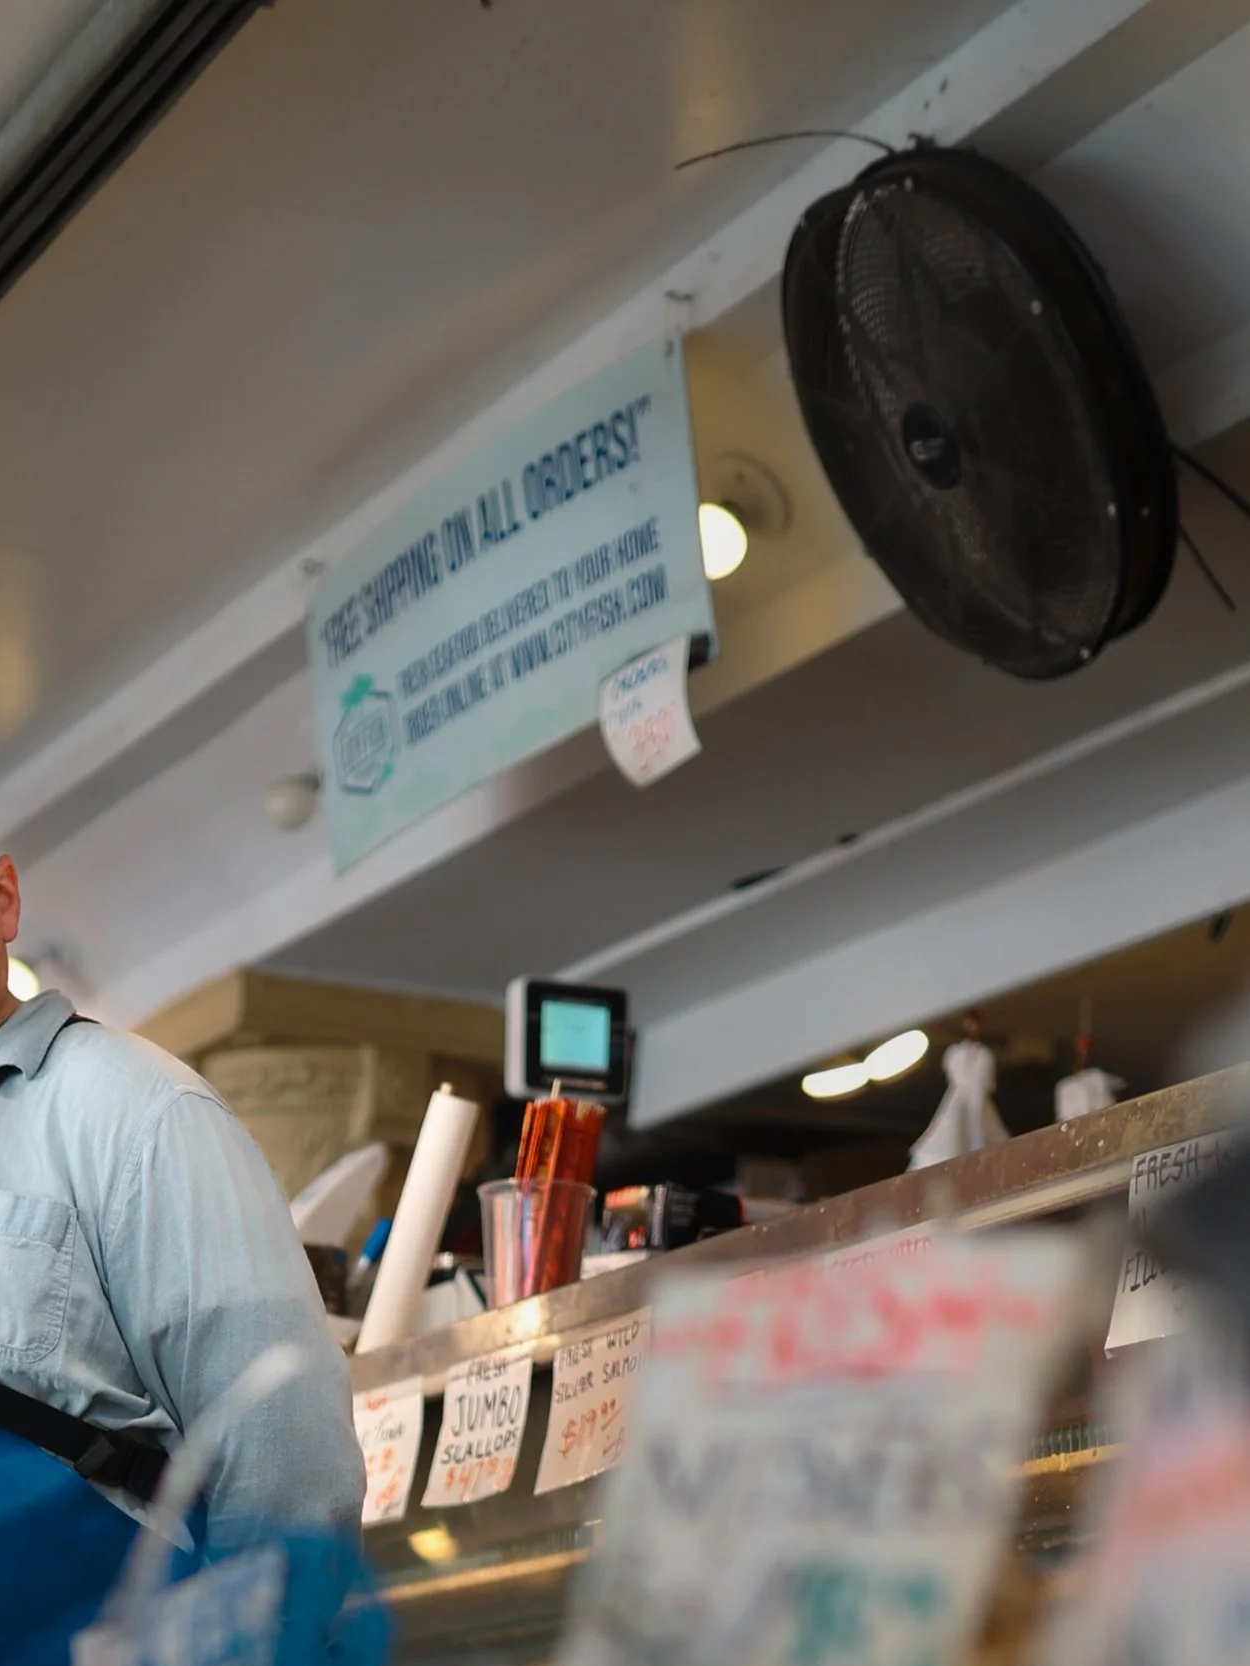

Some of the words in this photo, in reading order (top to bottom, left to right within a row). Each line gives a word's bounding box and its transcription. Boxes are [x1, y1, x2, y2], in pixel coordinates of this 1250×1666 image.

[359, 530, 442, 637] SHIPPING
[440, 503, 477, 575] ON
[477, 478, 523, 553] ALL
[551, 564, 571, 603] TO
[574, 541, 612, 590] YOUR
[615, 514, 661, 569] HOME
[1133, 1141, 1199, 1195] FRESH
[606, 1320, 640, 1351] WILD
[466, 1357, 510, 1387] FRESH
[554, 1370, 595, 1405] SILVER
[451, 1384, 523, 1437] JUMBO
[440, 1427, 519, 1465] SCALLOPS
